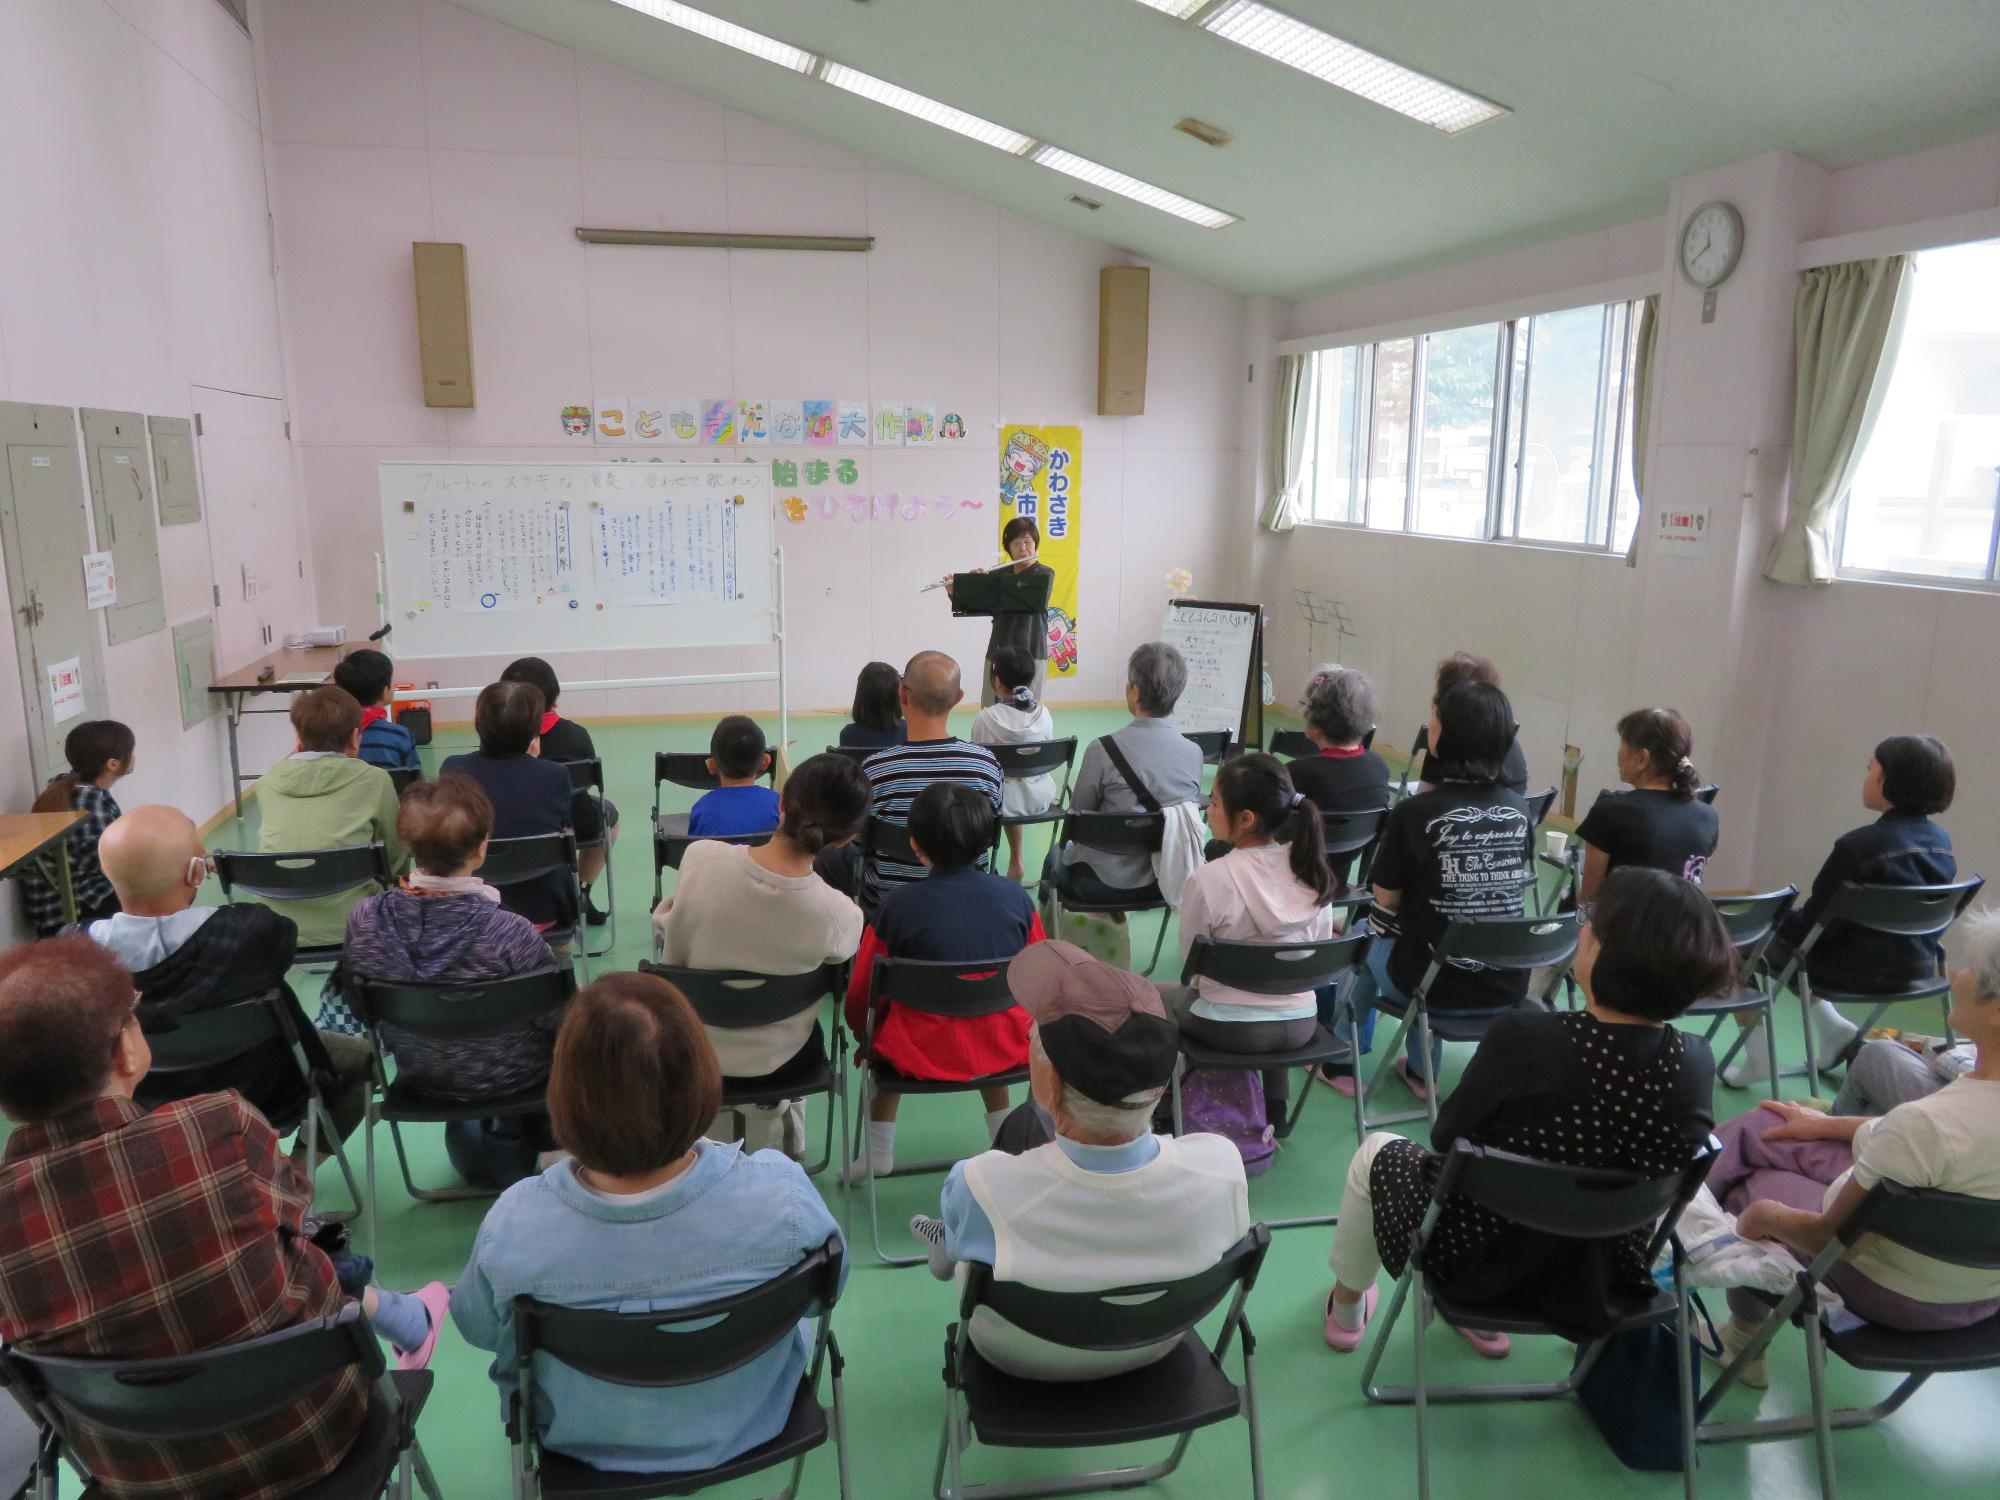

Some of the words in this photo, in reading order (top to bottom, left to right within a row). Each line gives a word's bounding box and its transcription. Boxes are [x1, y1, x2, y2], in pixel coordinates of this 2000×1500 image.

[1049, 449, 1070, 537] かわさき
[1432, 823, 1460, 849] Joy
[1462, 830, 1473, 841] to
[1475, 830, 1513, 846] express
[1442, 873, 1457, 883] THE
[1458, 872, 1479, 882] THING
[1480, 872, 1489, 881] TO
[1491, 870, 1511, 880] THINK
